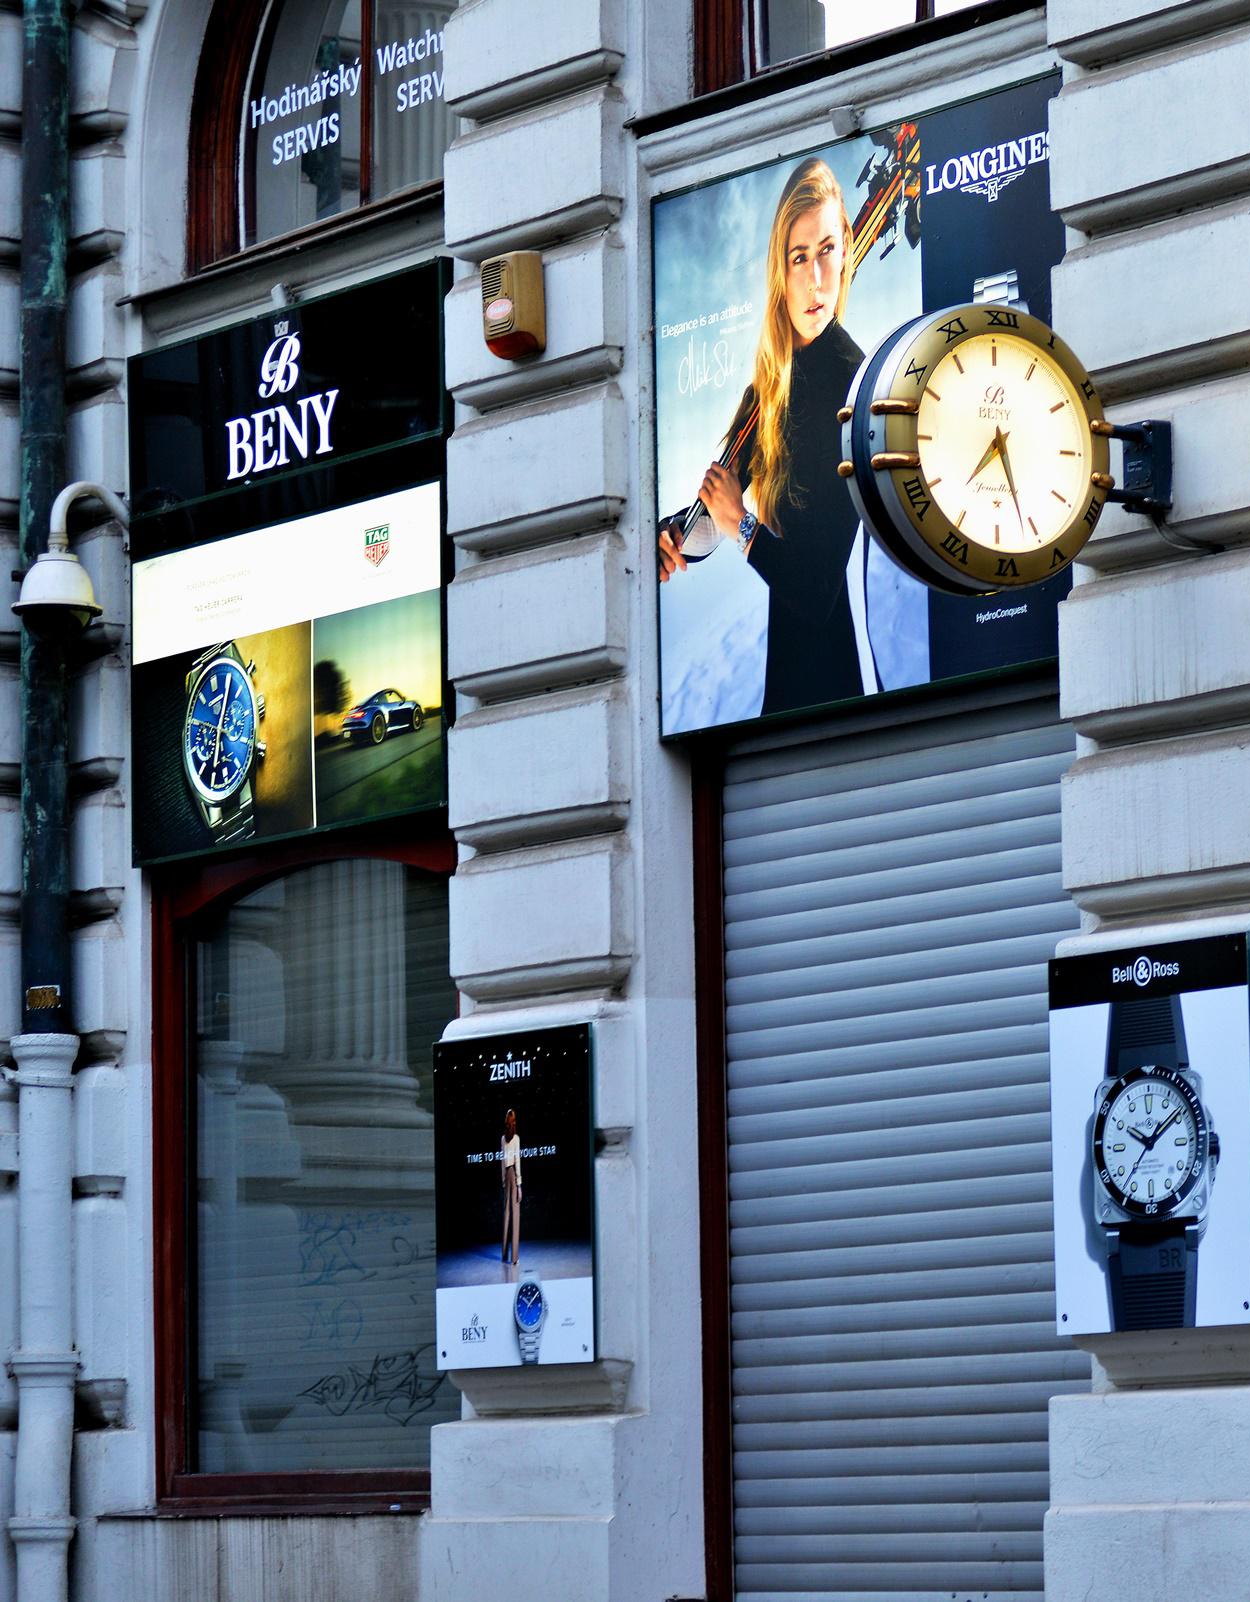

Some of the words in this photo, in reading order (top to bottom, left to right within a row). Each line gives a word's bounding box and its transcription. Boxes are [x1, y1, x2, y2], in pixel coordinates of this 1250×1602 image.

[251, 57, 362, 129] Hodinářský
[272, 112, 340, 166] SERVIS
[661, 318, 698, 339] Elegance
[700, 313, 707, 327] is
[708, 311, 719, 325] an
[720, 300, 753, 321] attitude
[984, 310, 1019, 329] XII
[937, 317, 968, 344] XI
[904, 358, 928, 385] X
[979, 404, 1011, 421] BENY
[225, 389, 339, 480] BENY
[366, 528, 388, 545] TAG
[976, 604, 1027, 624] HydroConquest
[1112, 966, 1132, 983] Bell
[1153, 962, 1179, 977] Ross
[489, 1060, 531, 1081] ZENITH
[467, 1153, 482, 1164] TIME
[484, 1151, 494, 1162] TO
[520, 1147, 538, 1158] YOUR
[539, 1145, 556, 1157] STAR
[1159, 1248, 1182, 1268] BR
[462, 1326, 487, 1341] BENY
